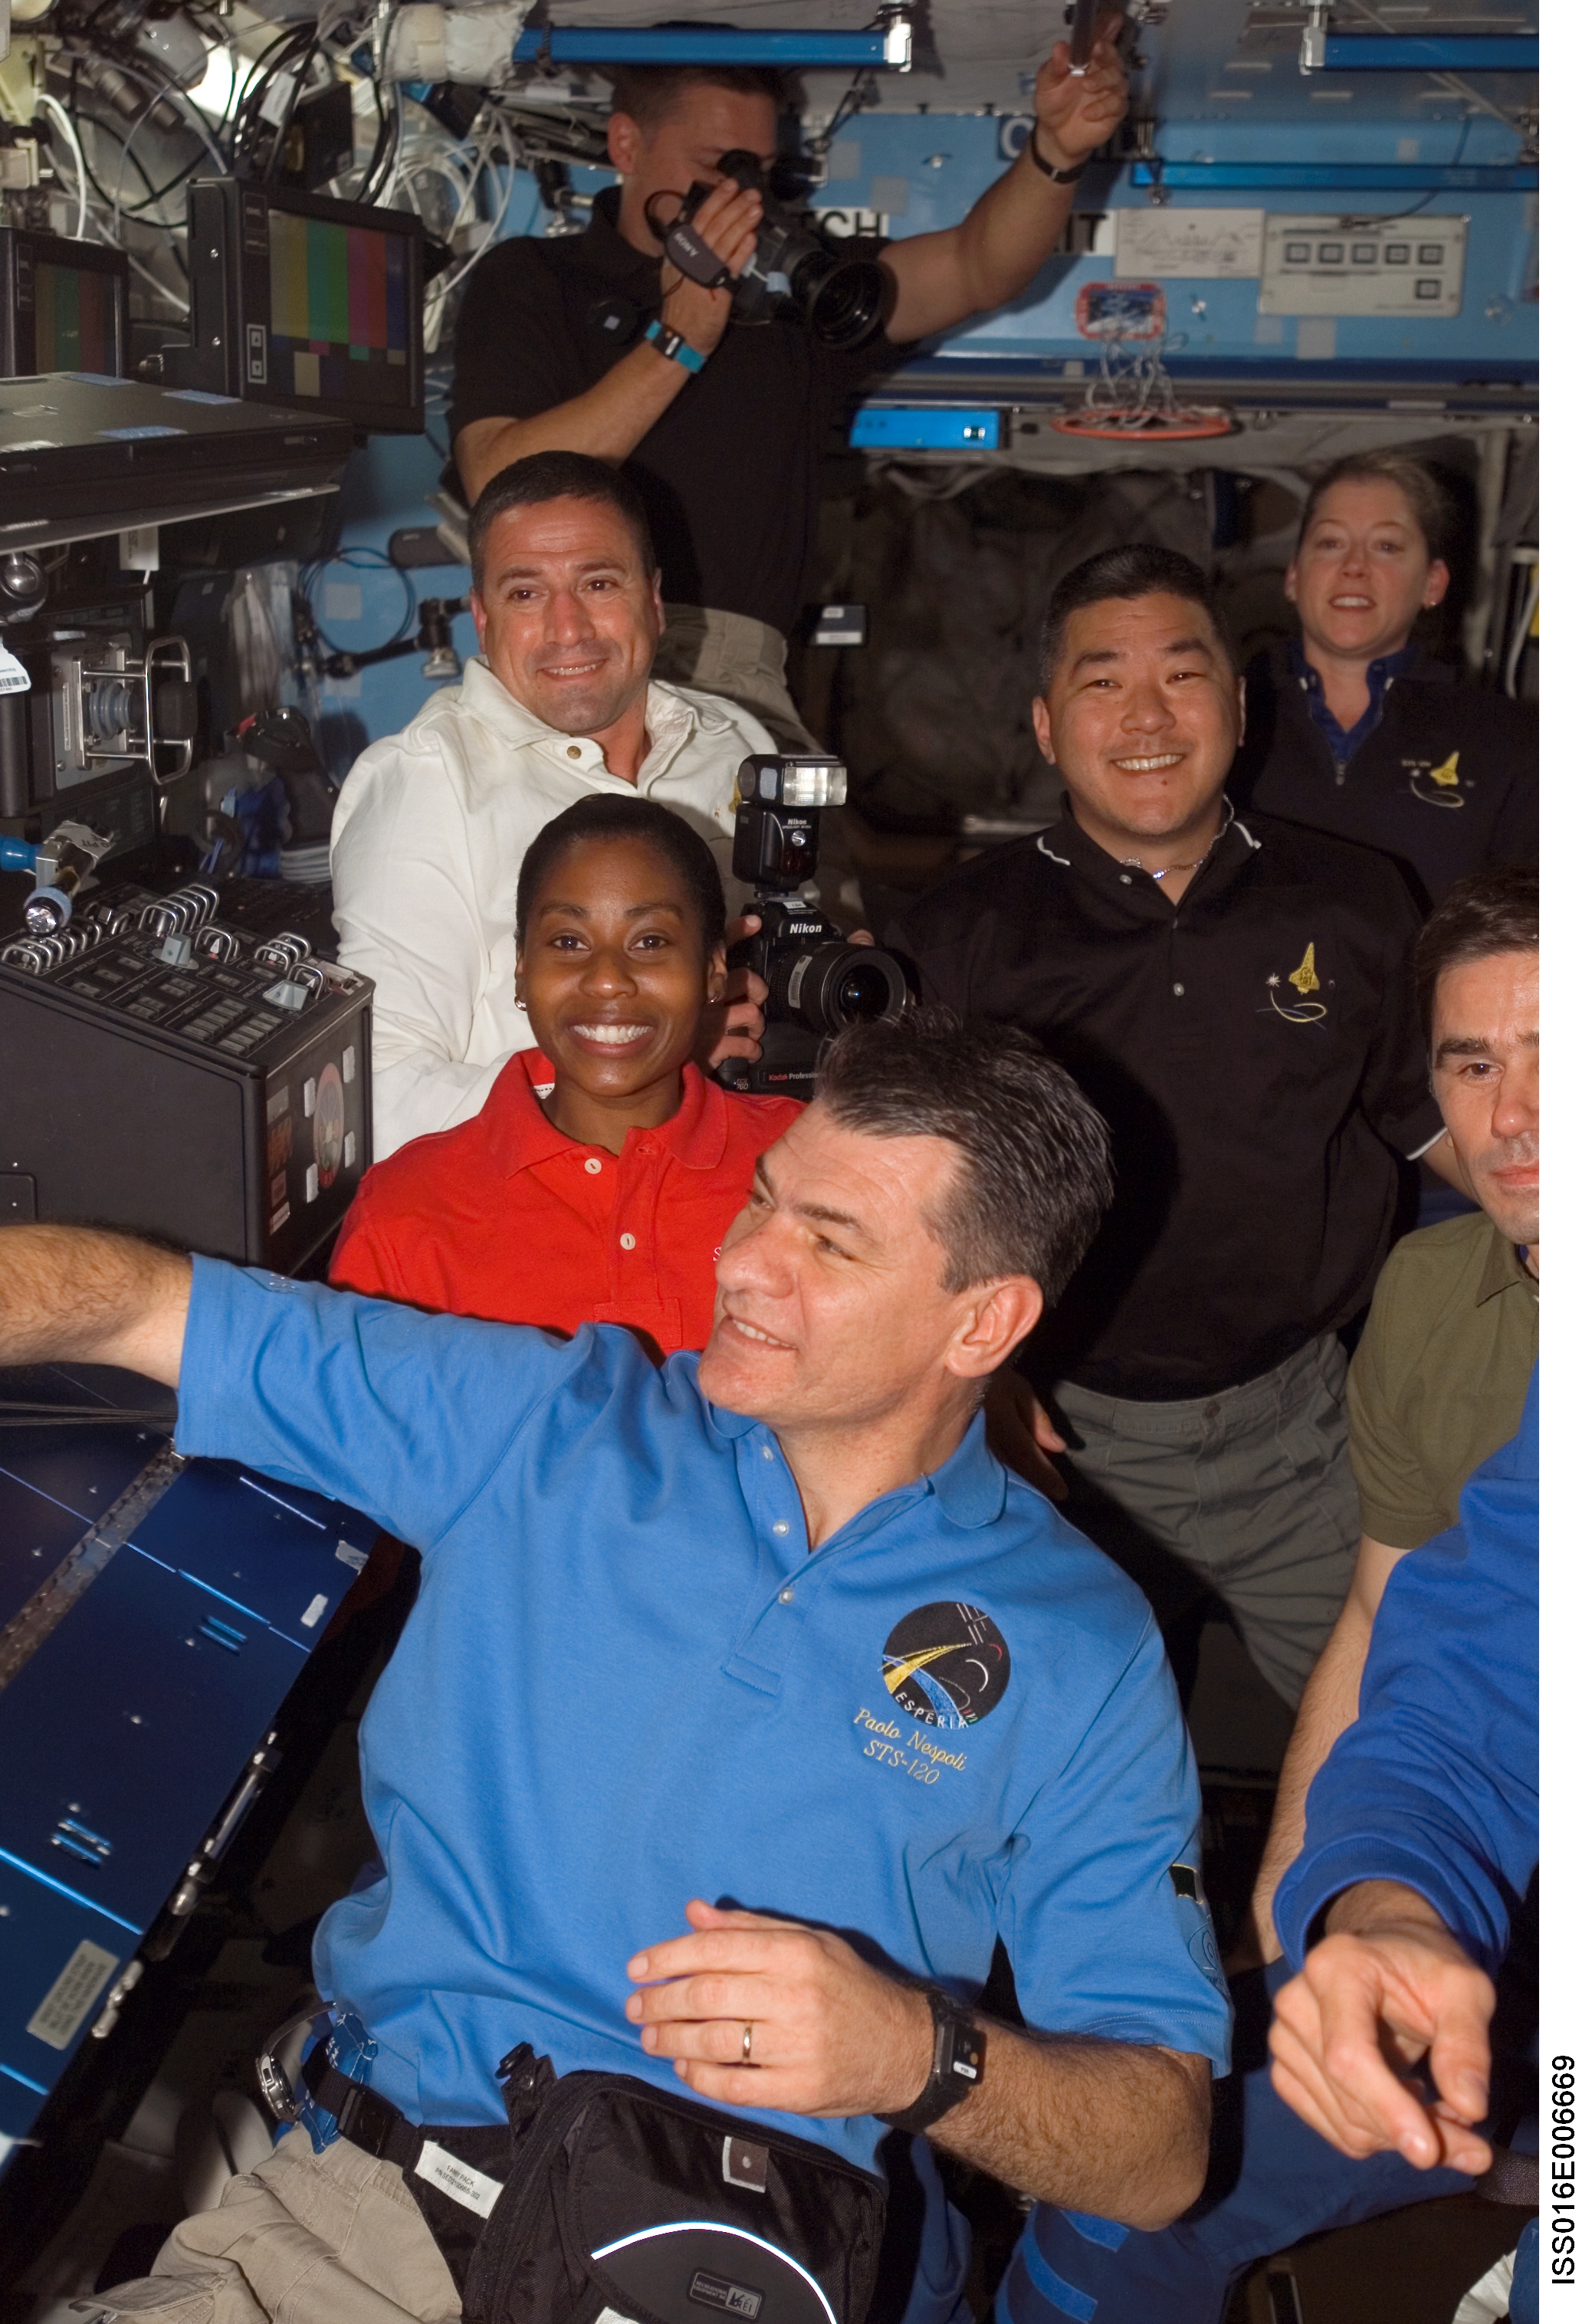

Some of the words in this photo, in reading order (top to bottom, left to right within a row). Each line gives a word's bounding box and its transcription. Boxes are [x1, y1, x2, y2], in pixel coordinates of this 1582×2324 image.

[789, 923, 822, 934] Nikon
[895, 1692, 970, 1730] ESPERIA
[853, 1708, 901, 1738] Paolo
[906, 1730, 968, 1771] Nespoli
[863, 1739, 940, 1784] STS-120
[460, 2174, 476, 2187] PACK
